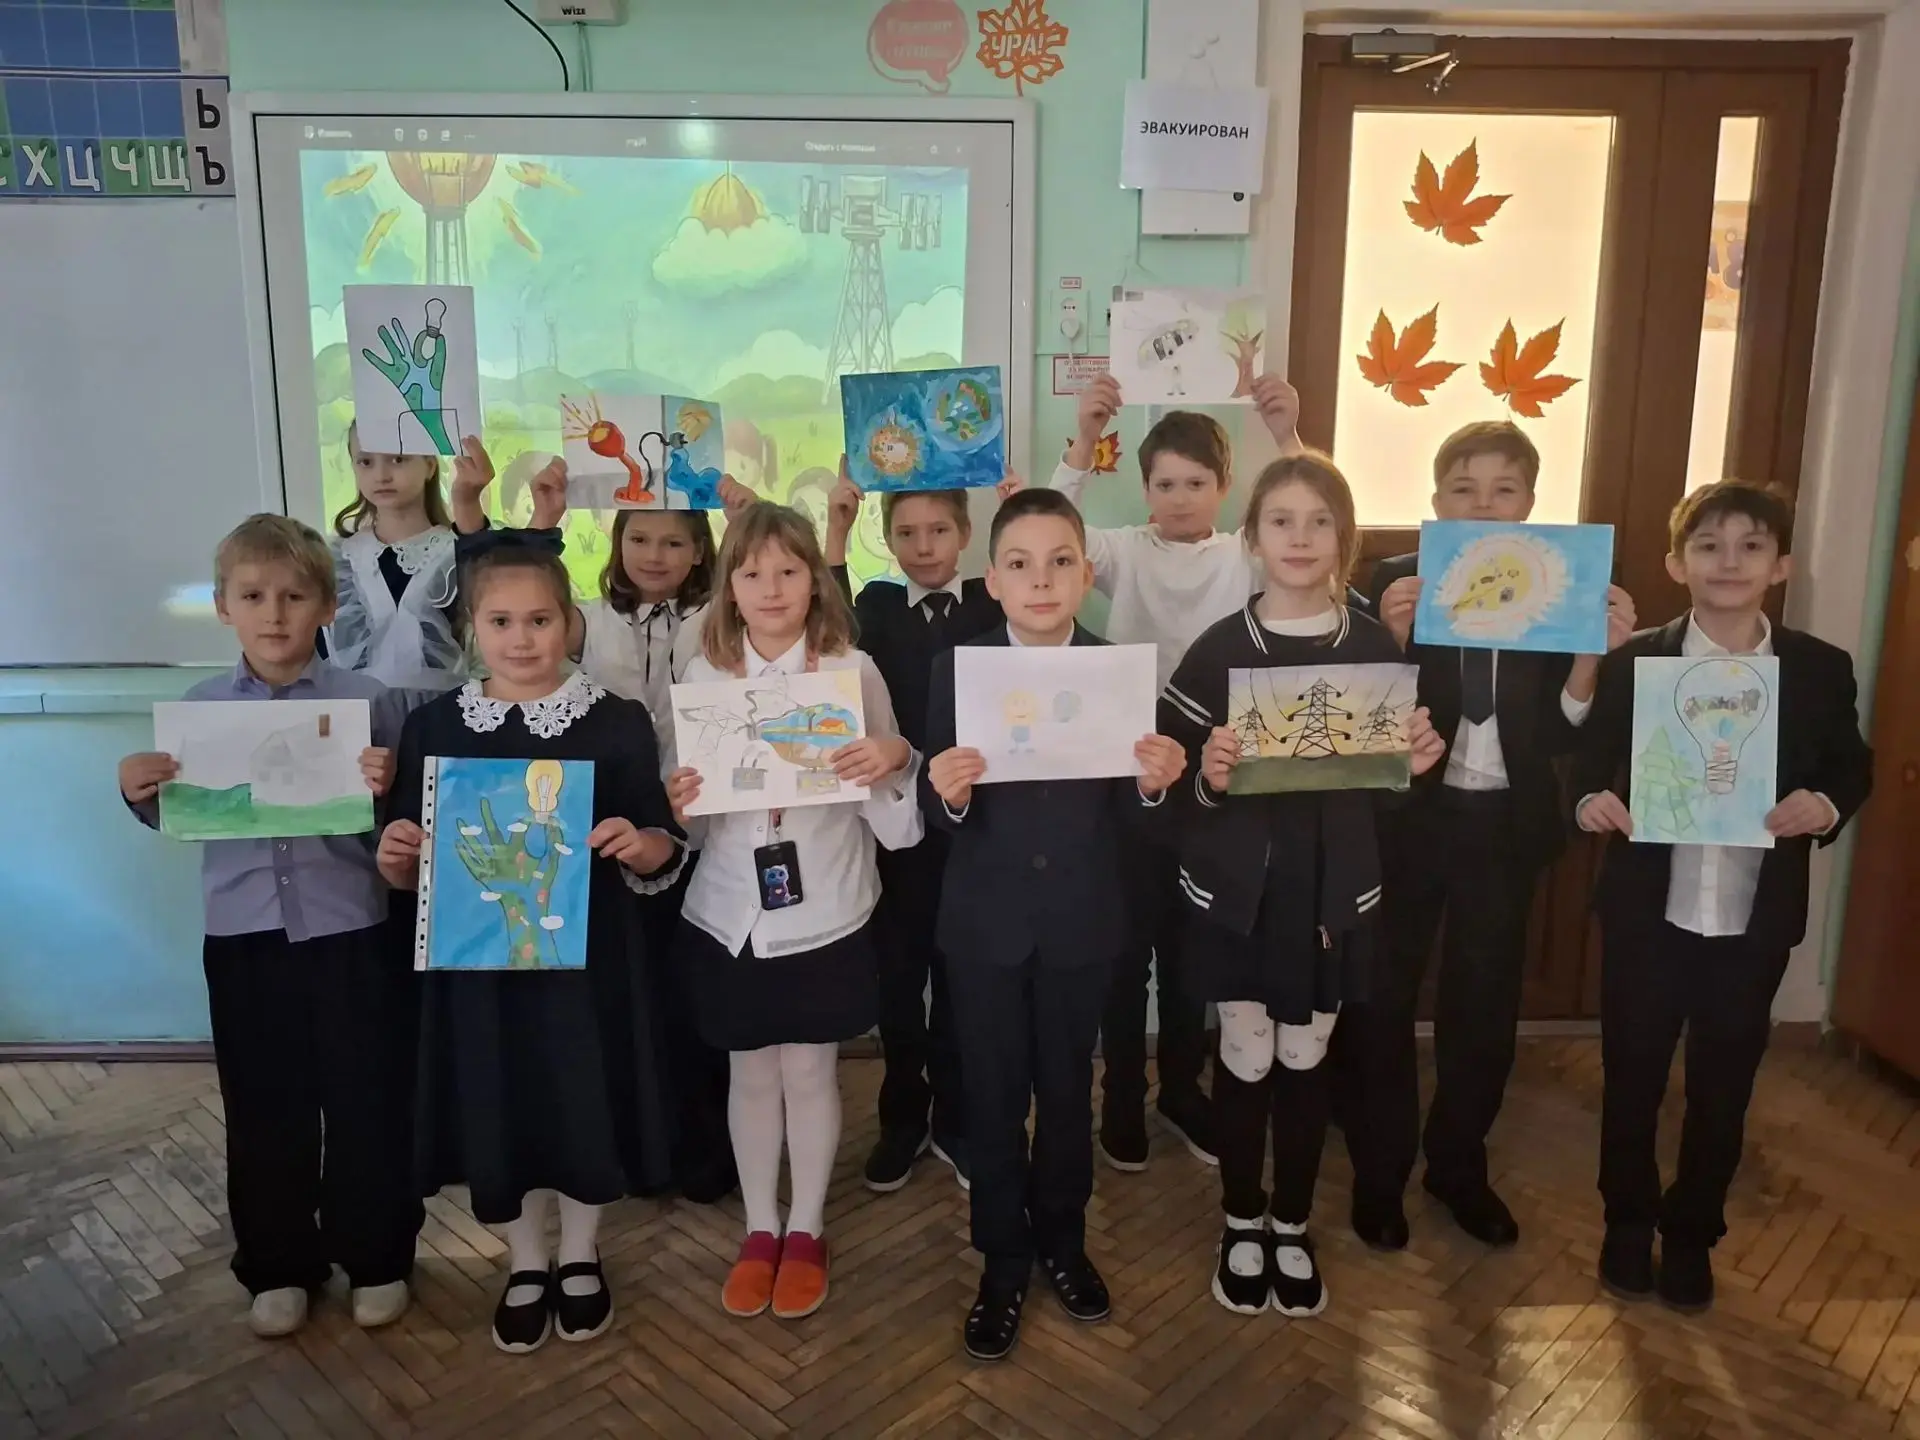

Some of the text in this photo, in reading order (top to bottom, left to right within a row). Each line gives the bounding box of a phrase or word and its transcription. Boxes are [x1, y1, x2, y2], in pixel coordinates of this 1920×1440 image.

[991, 33, 1044, 59] УРА!
[196, 88, 221, 129] Ь
[1139, 121, 1249, 139] ЭВАКУИРОВАН
